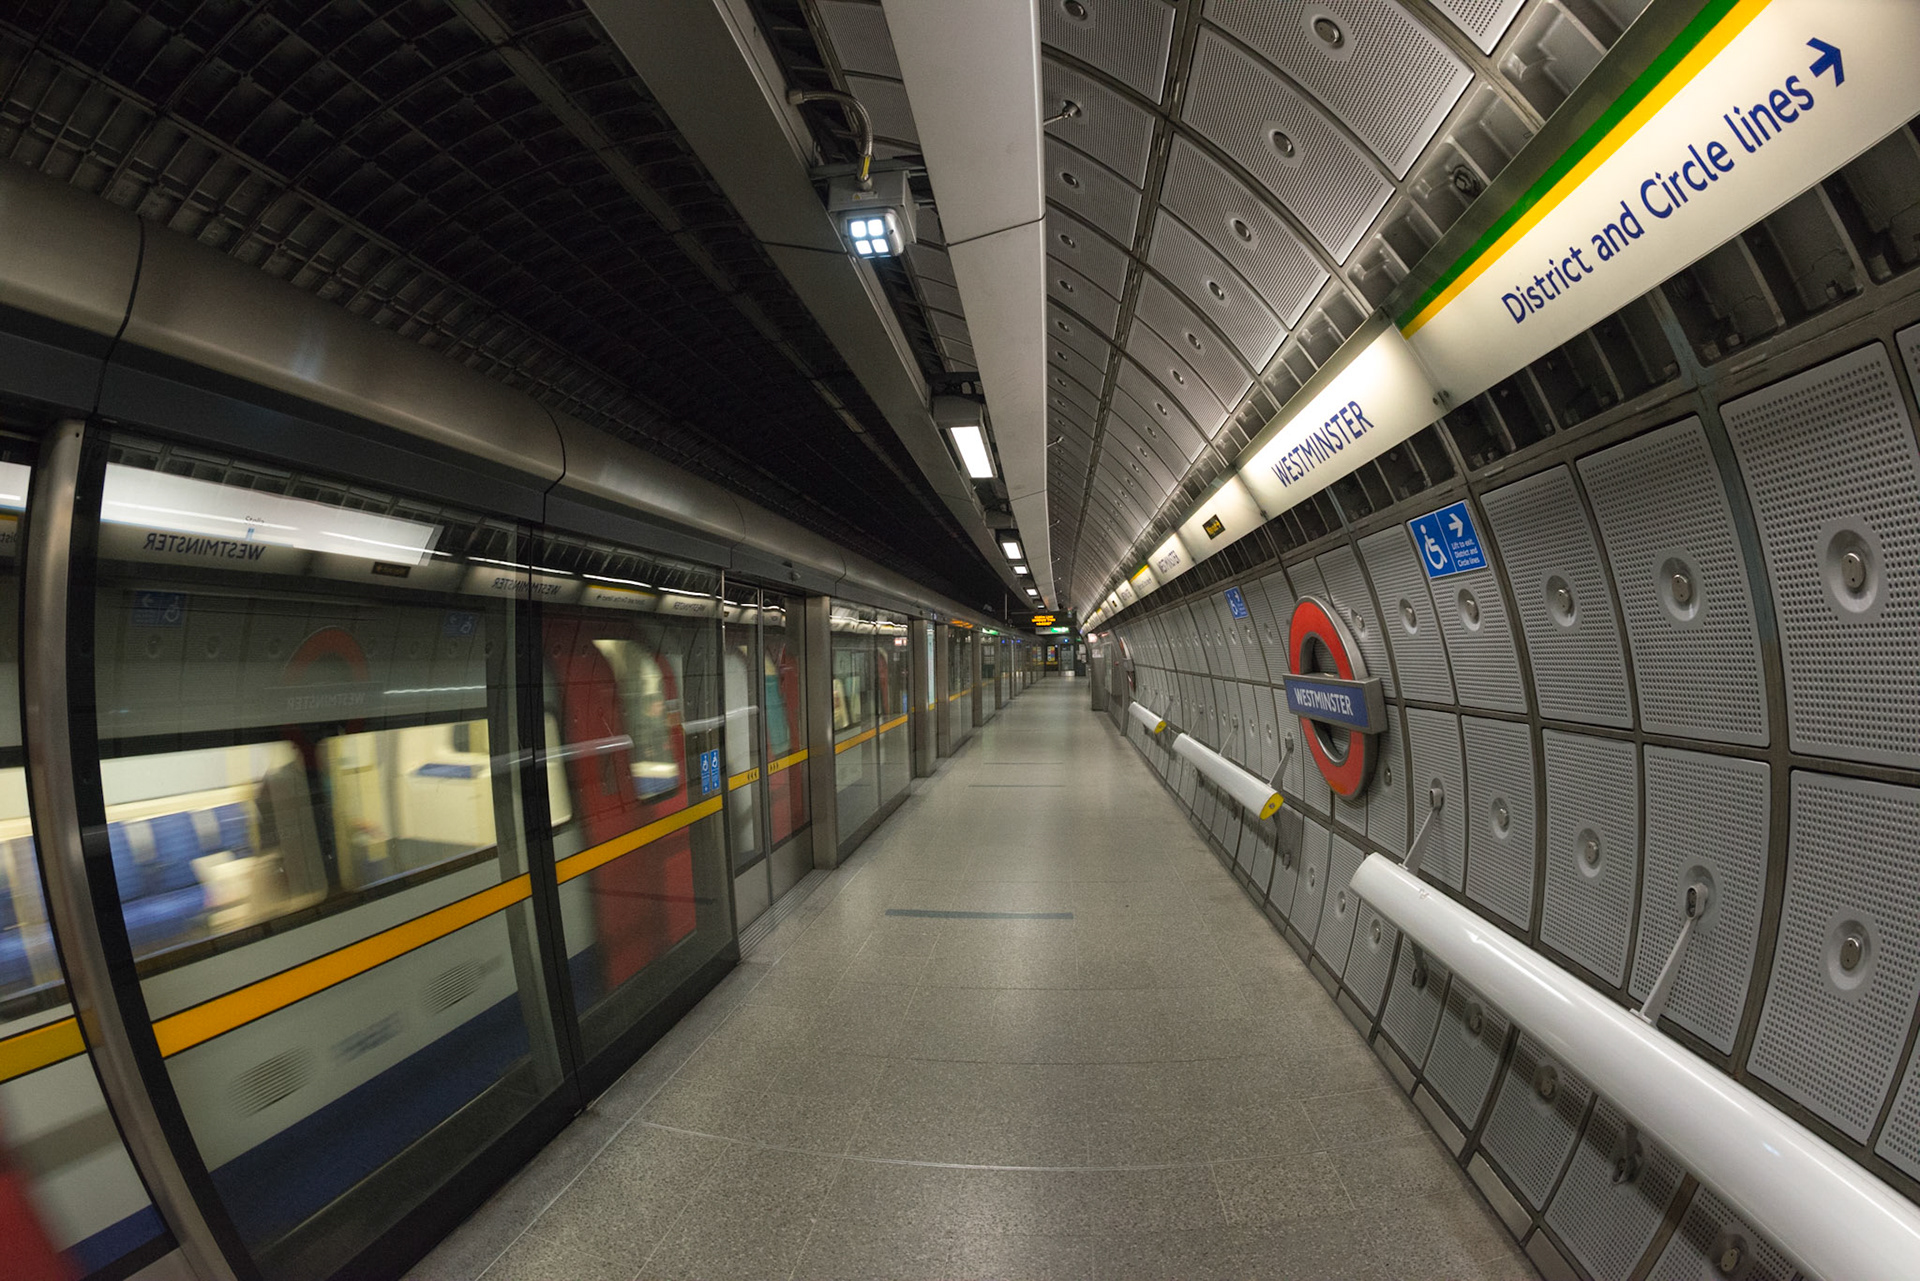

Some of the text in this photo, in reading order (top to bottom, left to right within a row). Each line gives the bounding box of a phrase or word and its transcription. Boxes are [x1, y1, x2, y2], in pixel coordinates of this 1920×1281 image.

[1501, 75, 1815, 324] District and Circle lines
[1271, 400, 1375, 488] WESTMINSTER
[1293, 687, 1354, 716] WESTMINSTER
